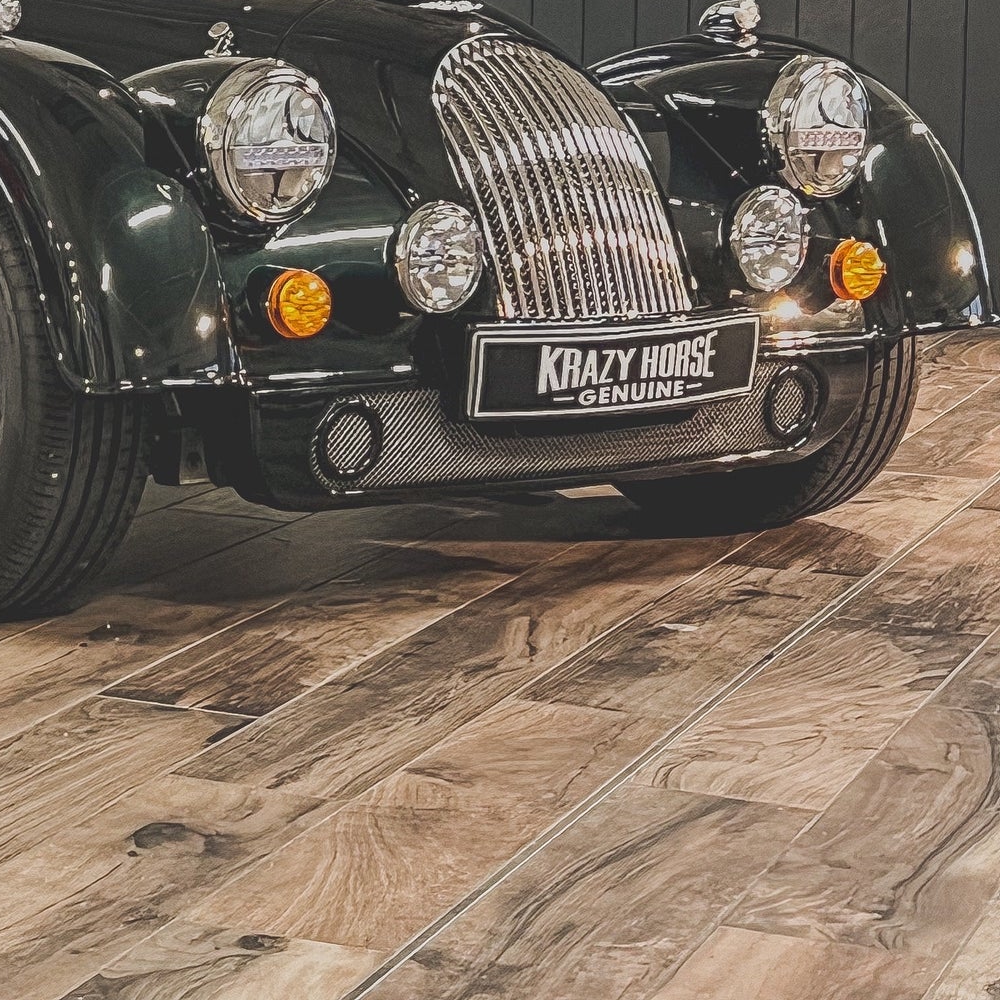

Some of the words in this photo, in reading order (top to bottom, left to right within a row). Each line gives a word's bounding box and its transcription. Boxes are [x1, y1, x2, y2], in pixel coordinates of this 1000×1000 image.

[537, 345, 638, 394] KRAZY
[640, 330, 719, 380] HORSE
[578, 380, 685, 406] GENUINE
